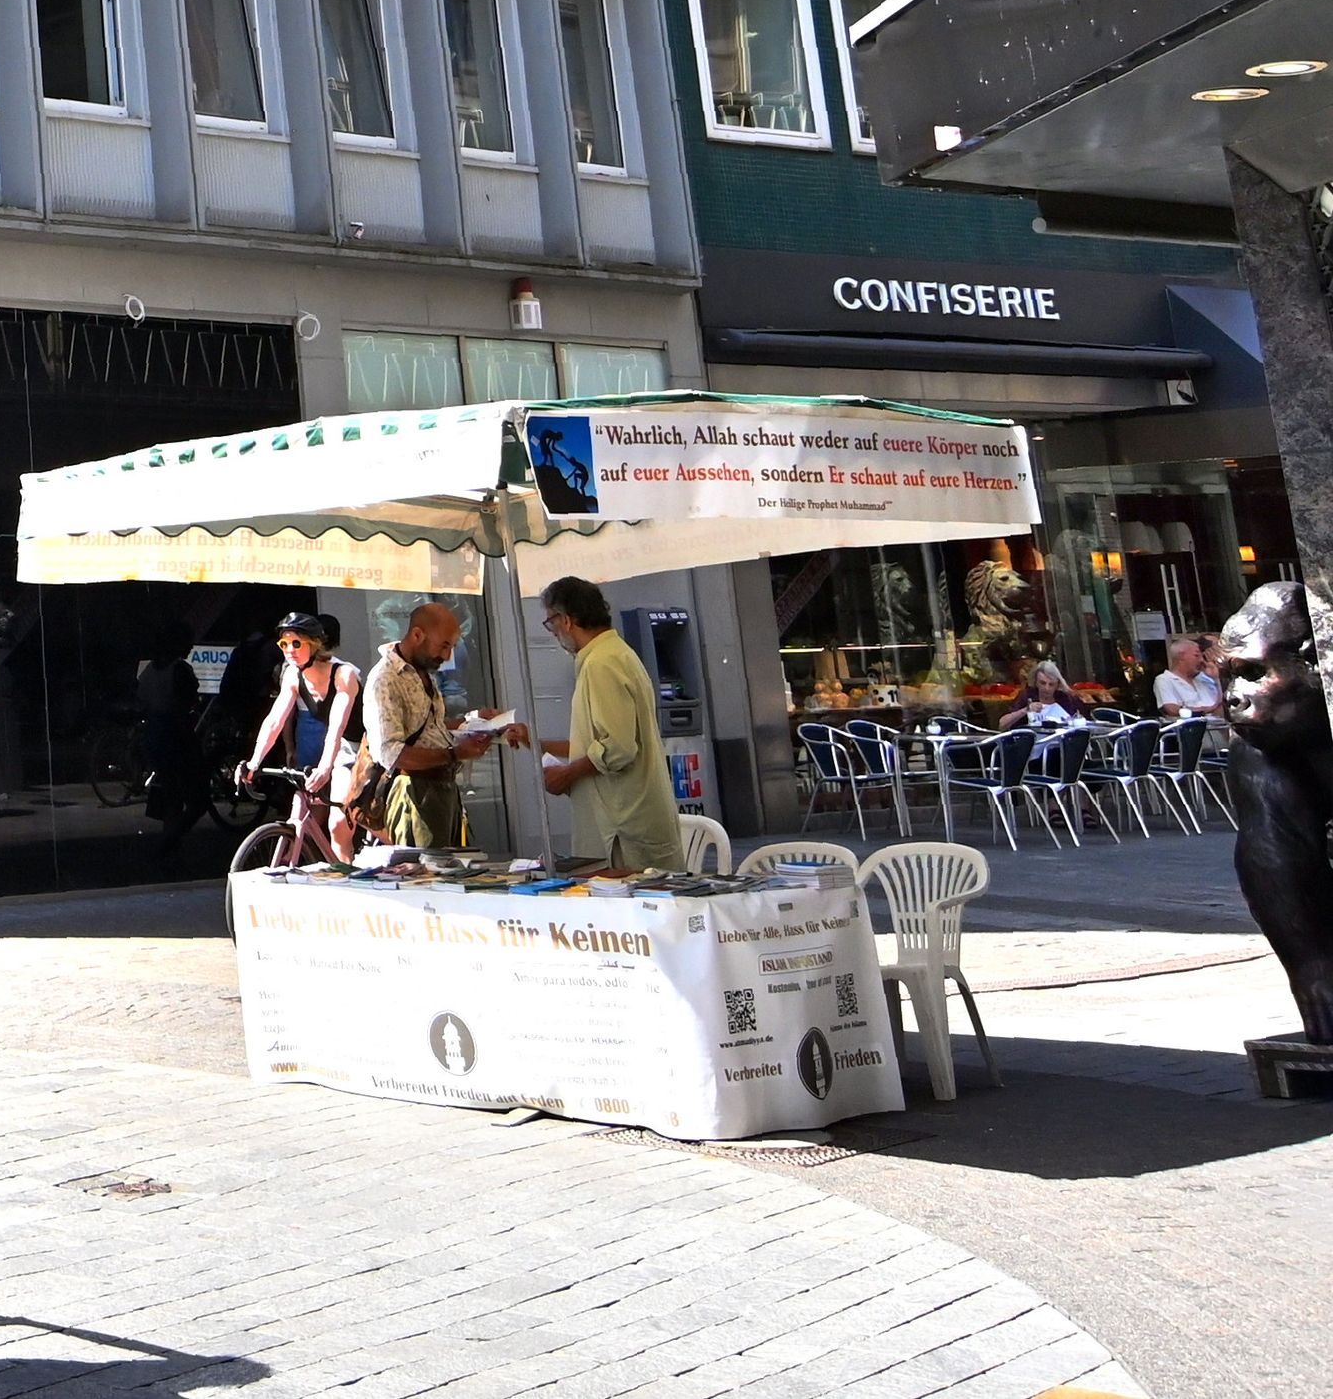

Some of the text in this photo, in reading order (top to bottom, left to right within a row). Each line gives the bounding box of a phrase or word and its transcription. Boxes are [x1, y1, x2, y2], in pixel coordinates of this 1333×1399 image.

[832, 277, 1061, 321] CONFISERIE
[693, 425, 738, 446] Allah
[742, 426, 795, 448] schaut
[799, 429, 849, 449] weder
[854, 432, 879, 450] auf
[883, 439, 923, 453] euere
[926, 435, 978, 460] Körper
[982, 439, 1019, 457] noch
[600, 462, 628, 482] auf
[633, 466, 670, 482] euer
[676, 462, 755, 485] Aussehen,
[761, 464, 824, 483] sondern
[828, 465, 846, 484] Er
[850, 467, 898, 486] schaut
[903, 469, 925, 487] auf
[930, 474, 960, 489] eure
[757, 497, 777, 508] Der
[497, 918, 540, 949] für
[548, 921, 651, 957] Keinen
[717, 930, 747, 944] Liebe
[724, 1048, 882, 1082] Verbreitet Frieden
